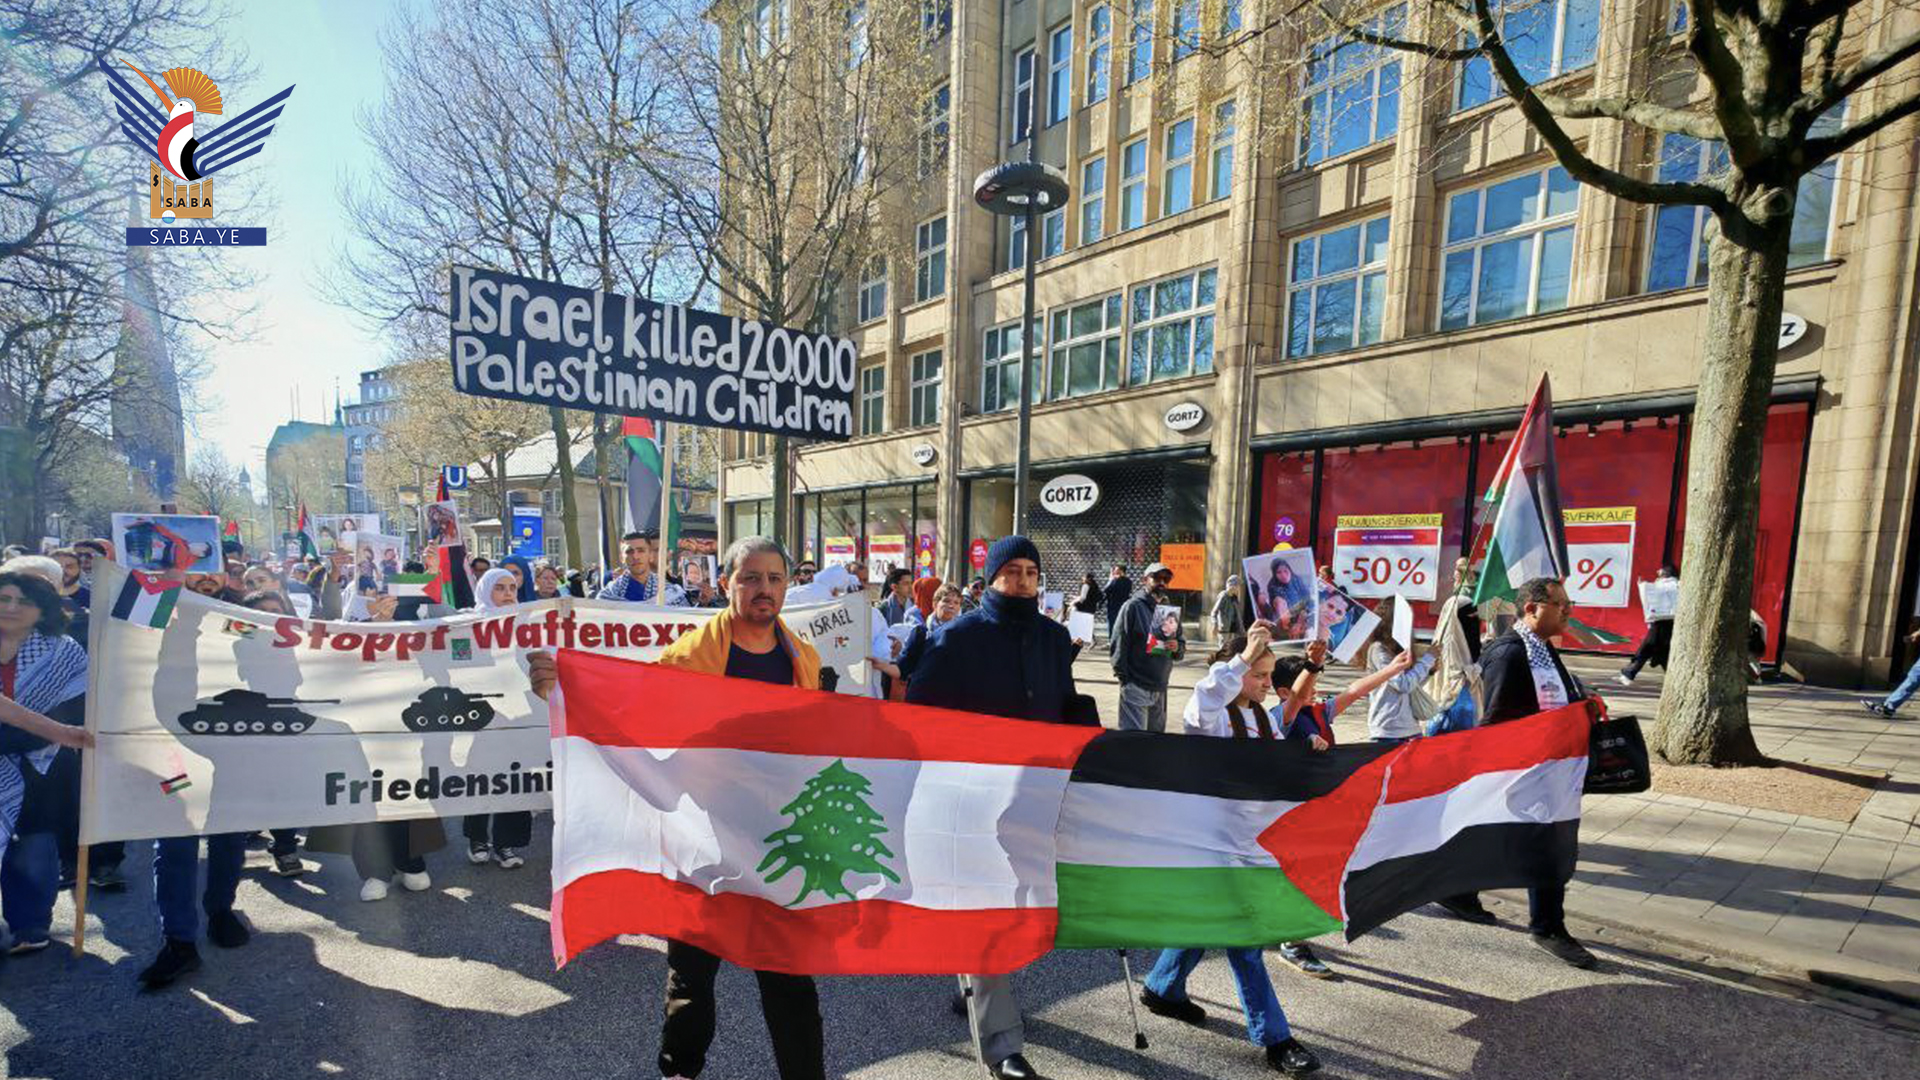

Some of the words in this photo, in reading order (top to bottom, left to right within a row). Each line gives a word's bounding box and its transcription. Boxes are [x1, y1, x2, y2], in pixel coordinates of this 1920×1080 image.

[453, 268, 613, 353] Israel
[624, 297, 740, 372] killed
[456, 336, 697, 417] Palestinian
[706, 374, 853, 436] Children
[445, 466, 464, 487] U
[1342, 557, 1391, 585] -50
[1397, 557, 1425, 586] %
[1577, 558, 1614, 590] %
[272, 617, 450, 661] Stoppt
[809, 608, 854, 638] ISRAEL
